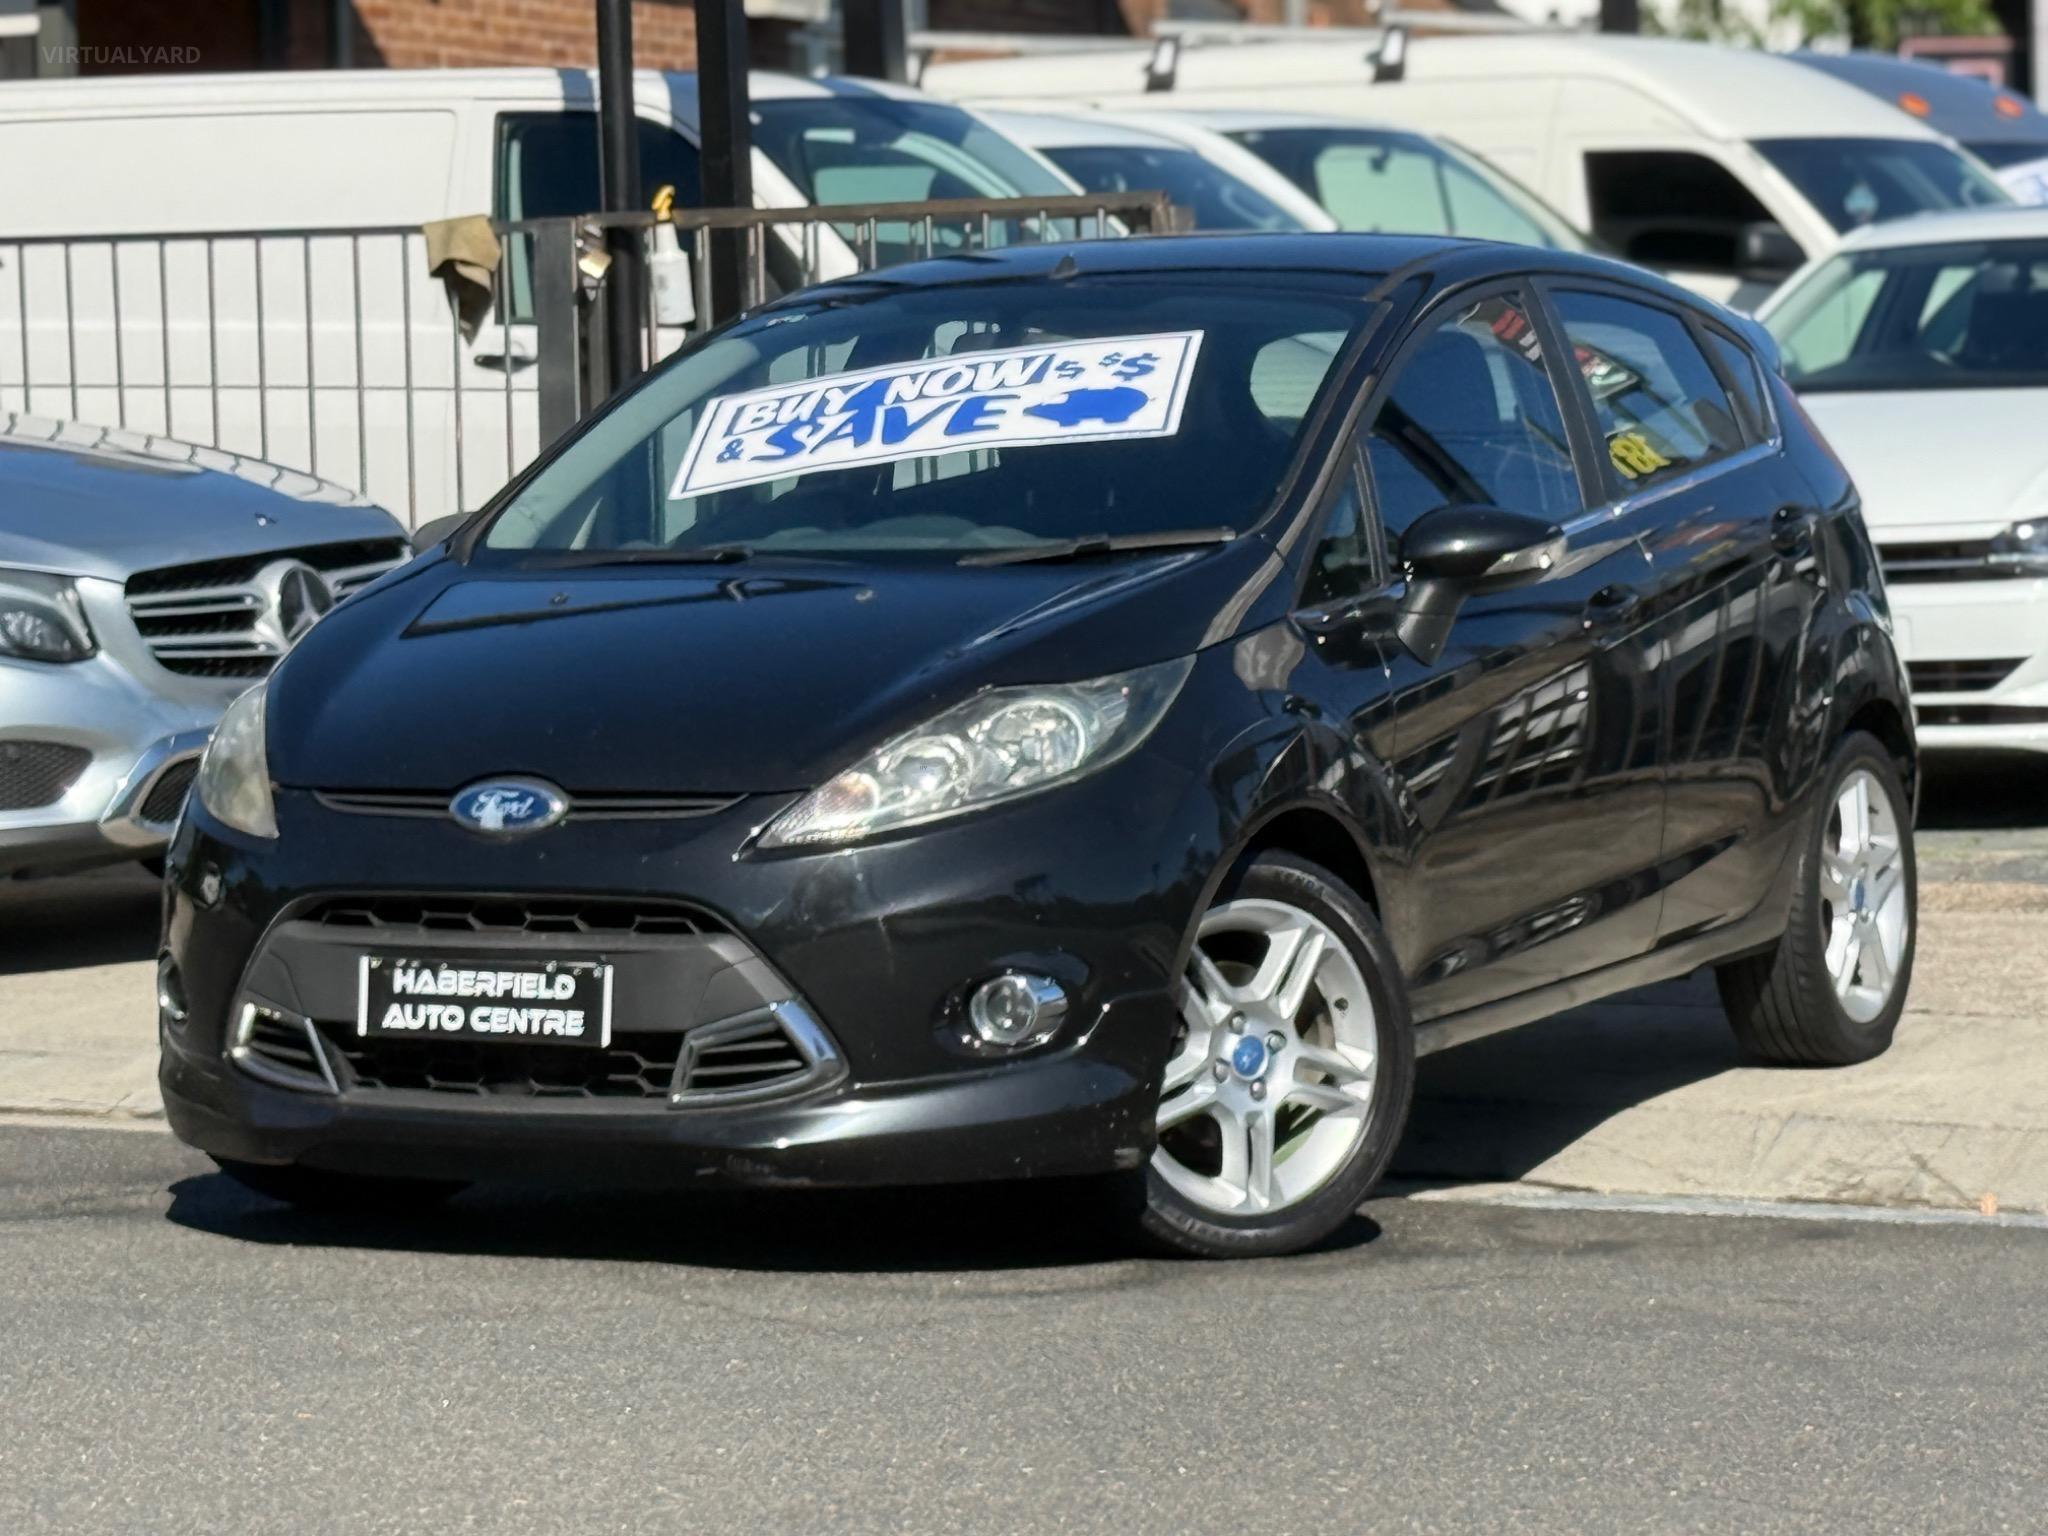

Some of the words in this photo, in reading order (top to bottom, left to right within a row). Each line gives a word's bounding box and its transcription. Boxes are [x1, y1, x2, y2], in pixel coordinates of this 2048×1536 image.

[732, 380, 877, 436] BUY
[883, 355, 1052, 405] NOW
[716, 438, 744, 464] &
[750, 380, 1021, 462] SAVE
[471, 789, 535, 819] Ford
[393, 968, 577, 1001] HABERFIELD
[381, 1003, 465, 1032] AUTO
[469, 1006, 586, 1037] CENTRE
